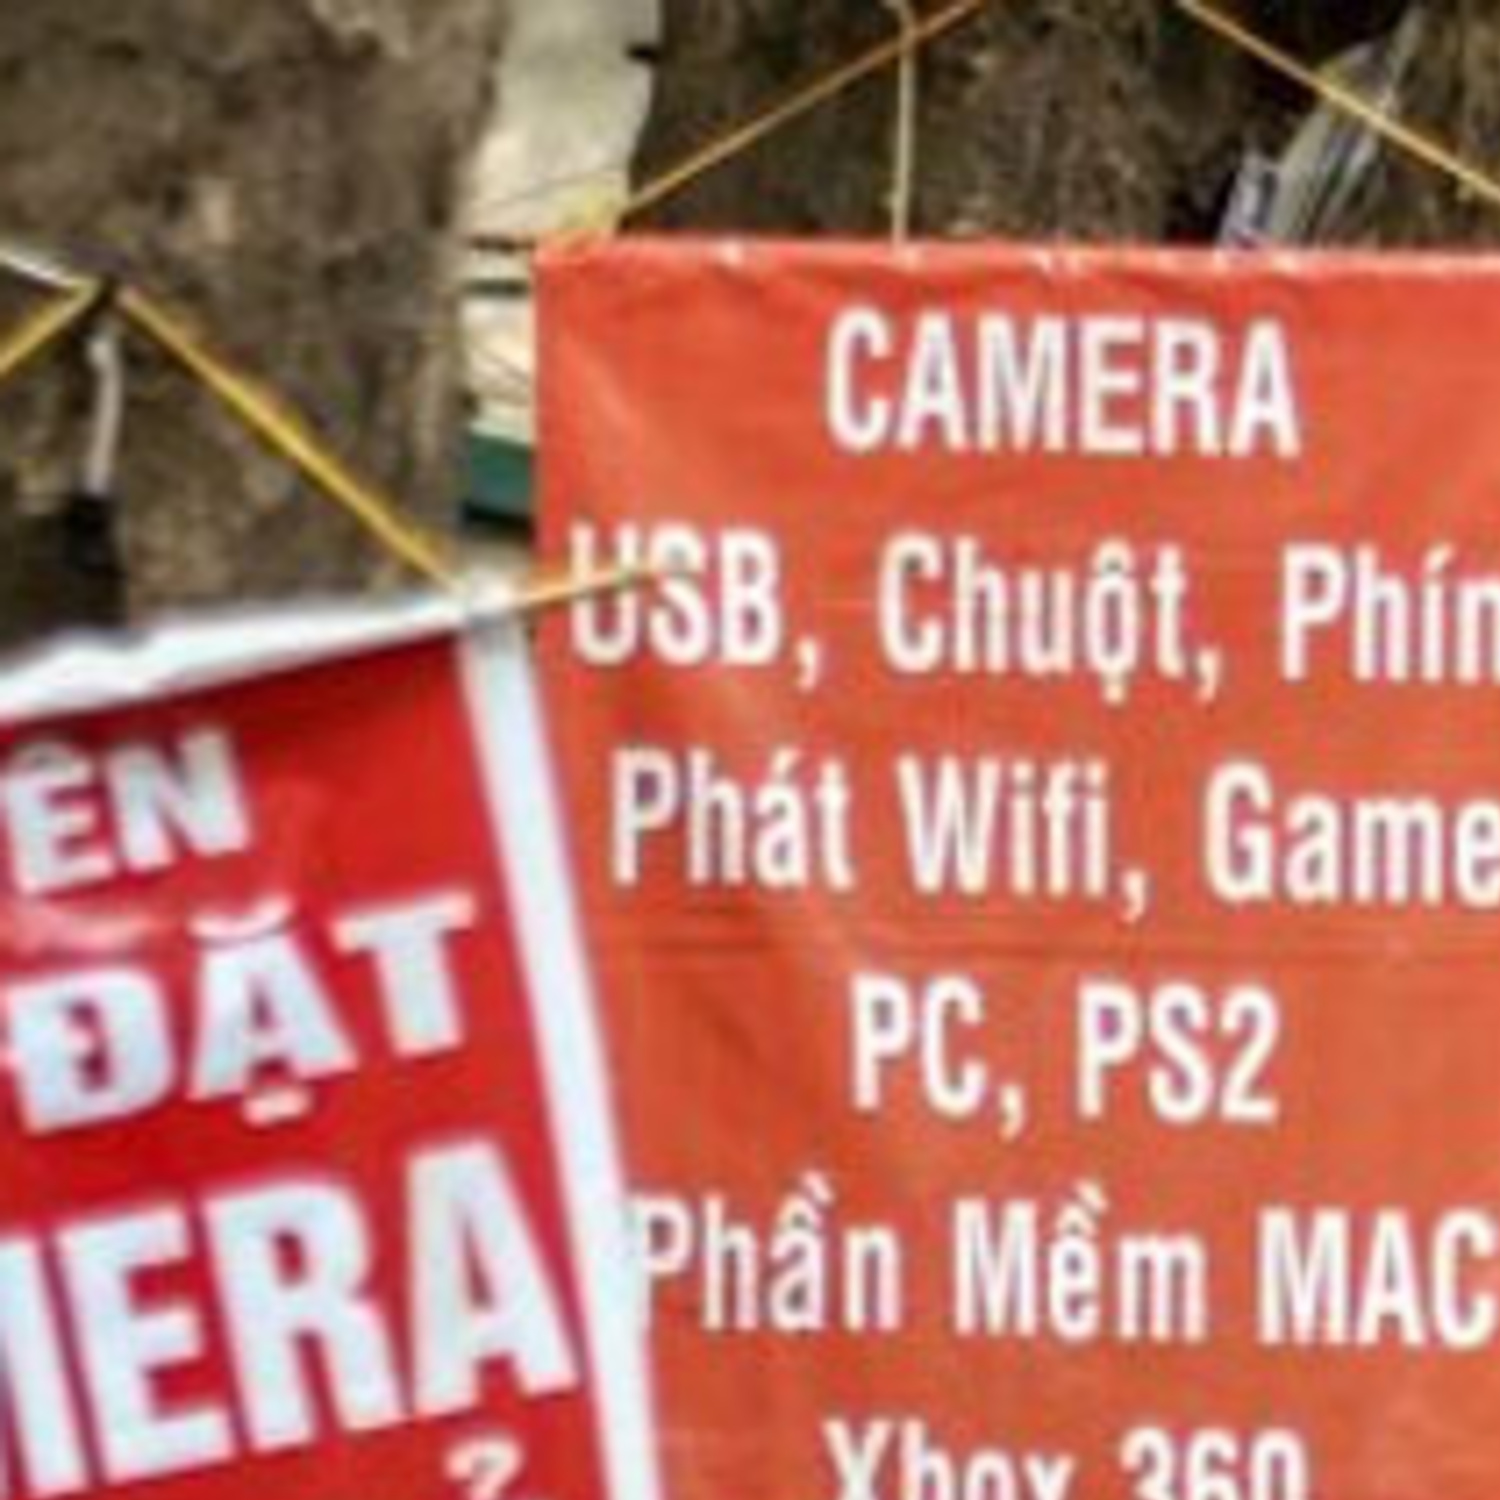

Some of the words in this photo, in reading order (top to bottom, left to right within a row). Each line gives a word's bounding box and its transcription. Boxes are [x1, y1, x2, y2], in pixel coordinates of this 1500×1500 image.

[823, 306, 1302, 458] CAMERA
[570, 521, 821, 691] USB,
[877, 530, 1222, 704] Chuột,
[610, 746, 854, 890] Phát
[897, 755, 1149, 921] Wifi,
[0, 893, 477, 1137] ĐẶT
[849, 973, 1025, 1138] PC,
[1076, 982, 1280, 1125] PS2
[628, 1171, 902, 1334] Phần
[954, 1178, 1203, 1341] Mềm
